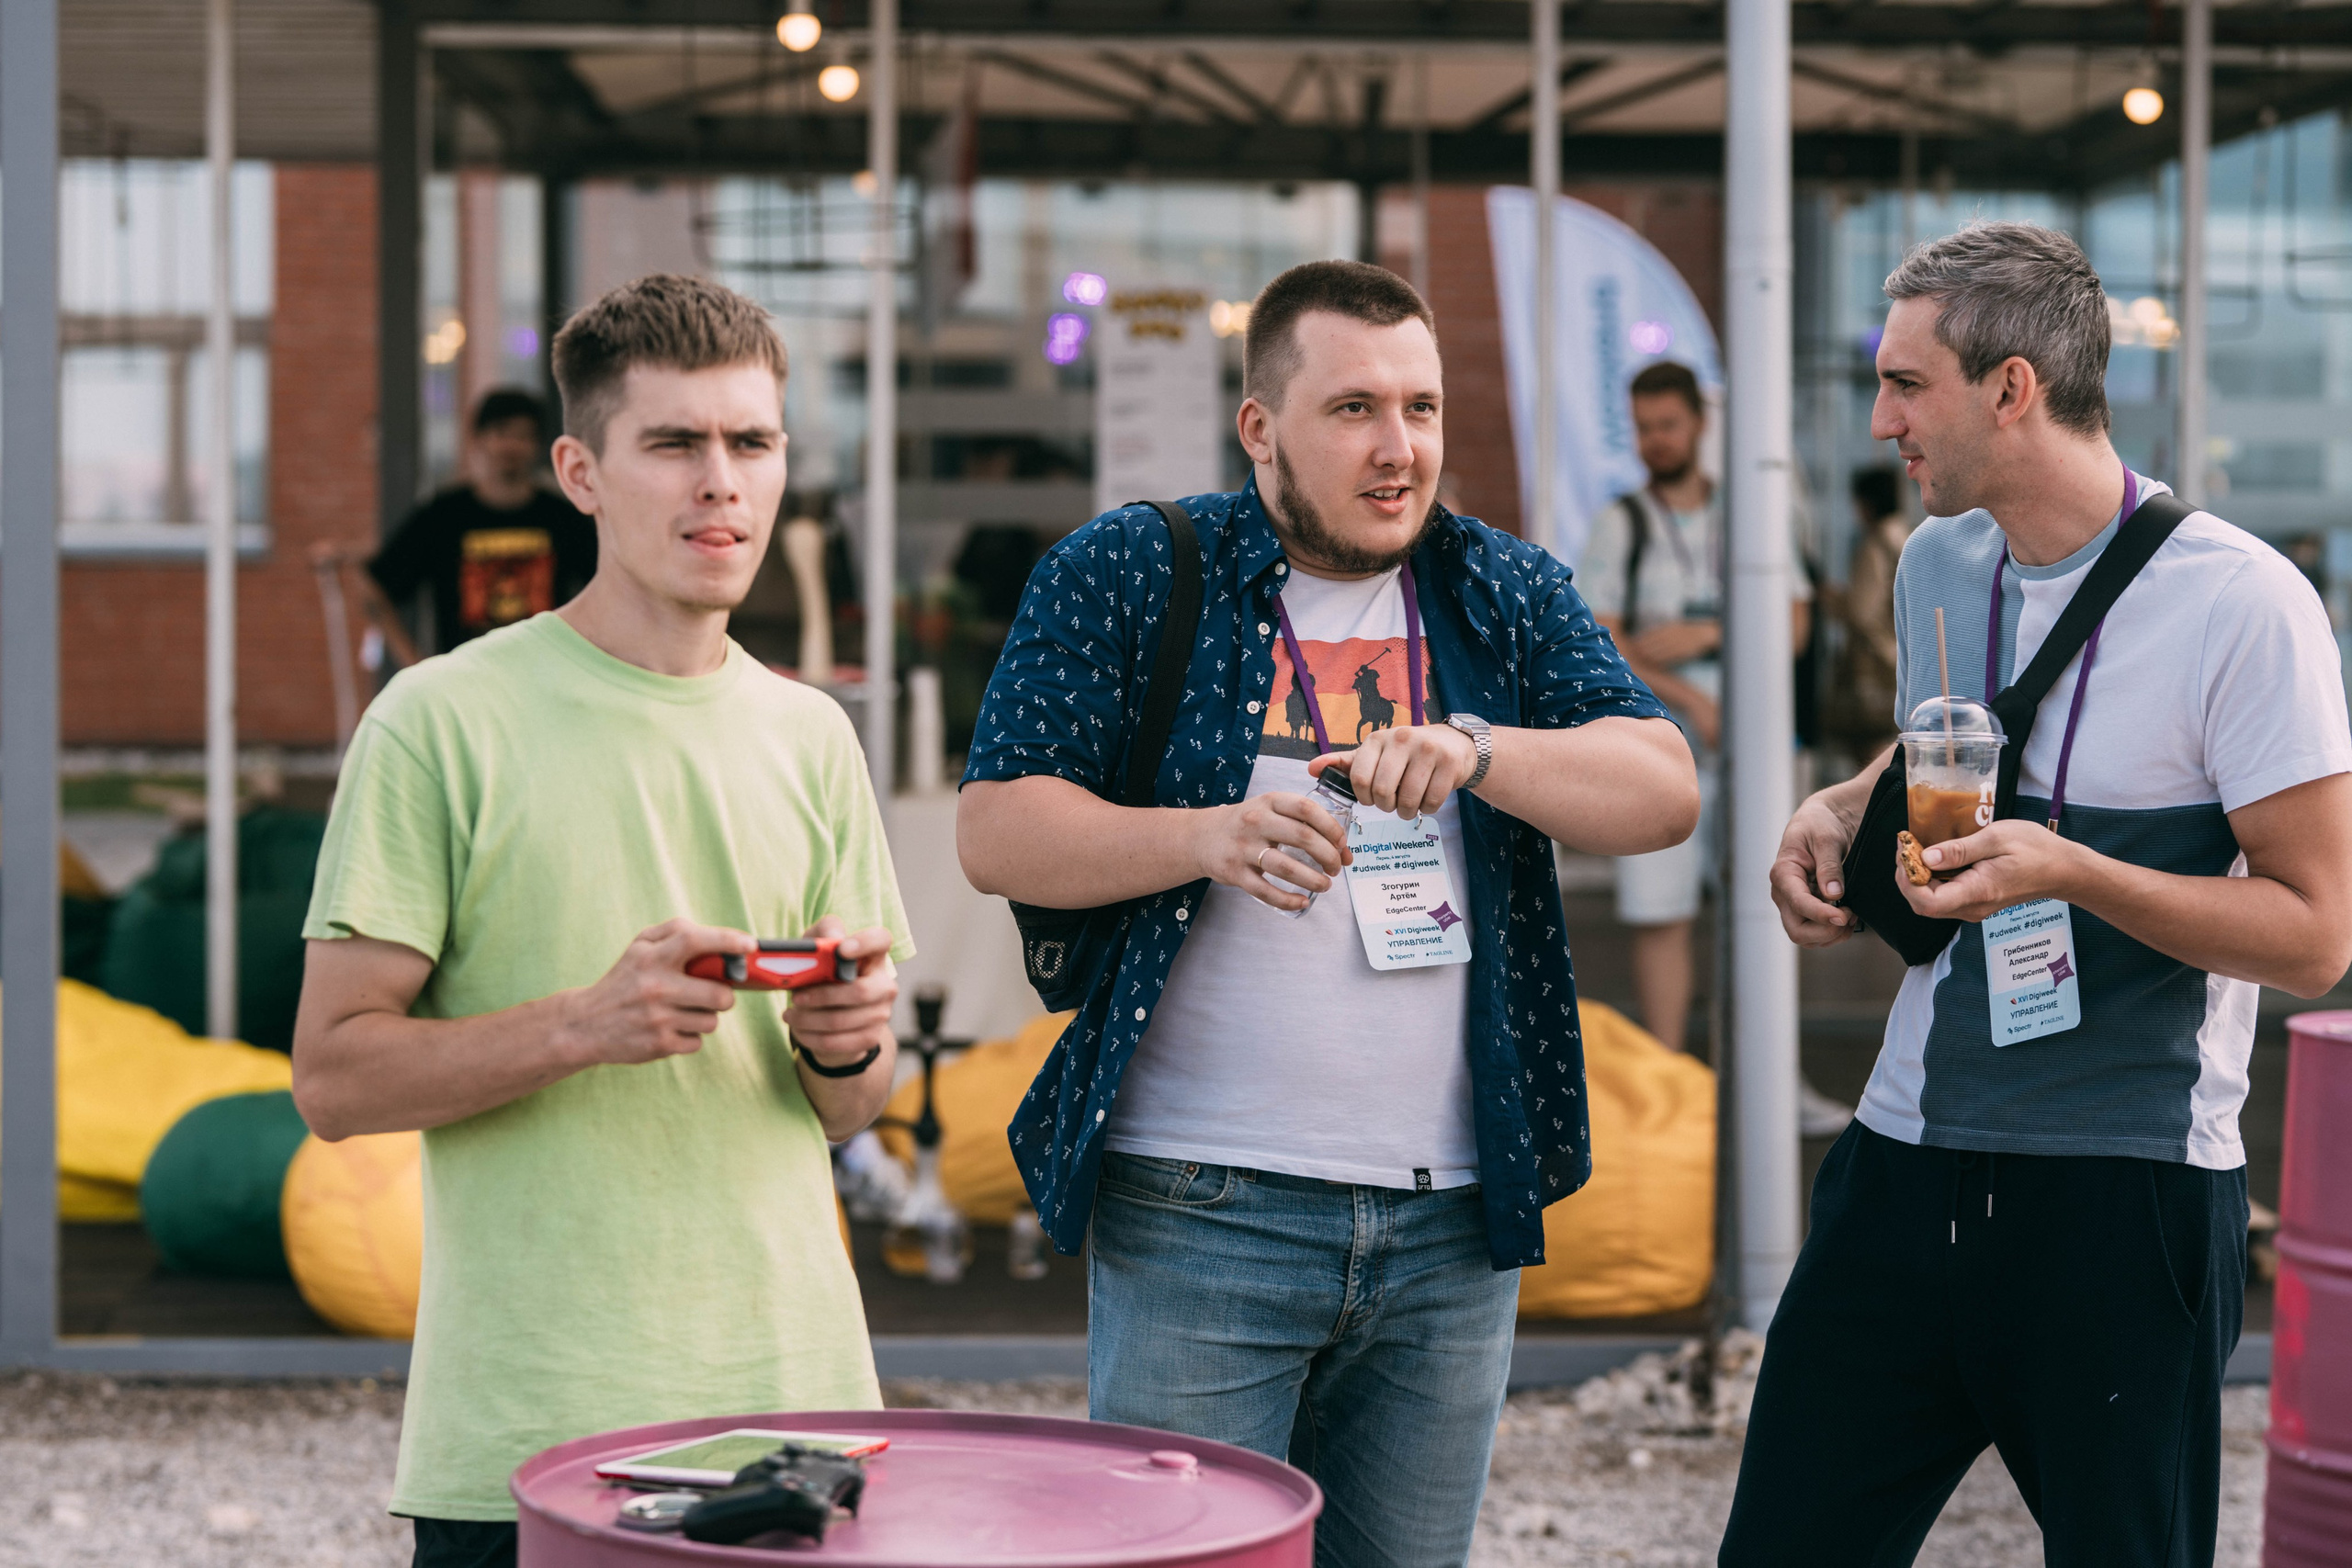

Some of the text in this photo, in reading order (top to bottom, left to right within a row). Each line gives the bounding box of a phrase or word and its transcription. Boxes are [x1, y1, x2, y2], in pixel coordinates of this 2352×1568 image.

[1349, 839, 1434, 854] ral Digital Weekend
[1351, 858, 1440, 873] #udweek #digiweek
[1381, 881, 1420, 891] Згогурин
[1389, 892, 1417, 901] Артём
[1385, 905, 1427, 915] EdgeCenter
[2000, 902, 2025, 916] Digital
[1408, 924, 1441, 935] Digiweek
[1988, 911, 2064, 939] #udweek #digiweek
[1387, 936, 1443, 948] УПРАВЛЕНИЕ
[2003, 938, 2052, 957] Грибенников
[1395, 953, 1416, 961] Spectr
[2008, 951, 2049, 966] Александр
[2012, 966, 2048, 981] EdgeCenter
[2029, 987, 2058, 1000] Digiweek
[2009, 1000, 2058, 1020] УПРАВЛЕНИЕ
[2043, 1014, 2064, 1025] TAGLINE
[2014, 1023, 2032, 1033] Spectr
